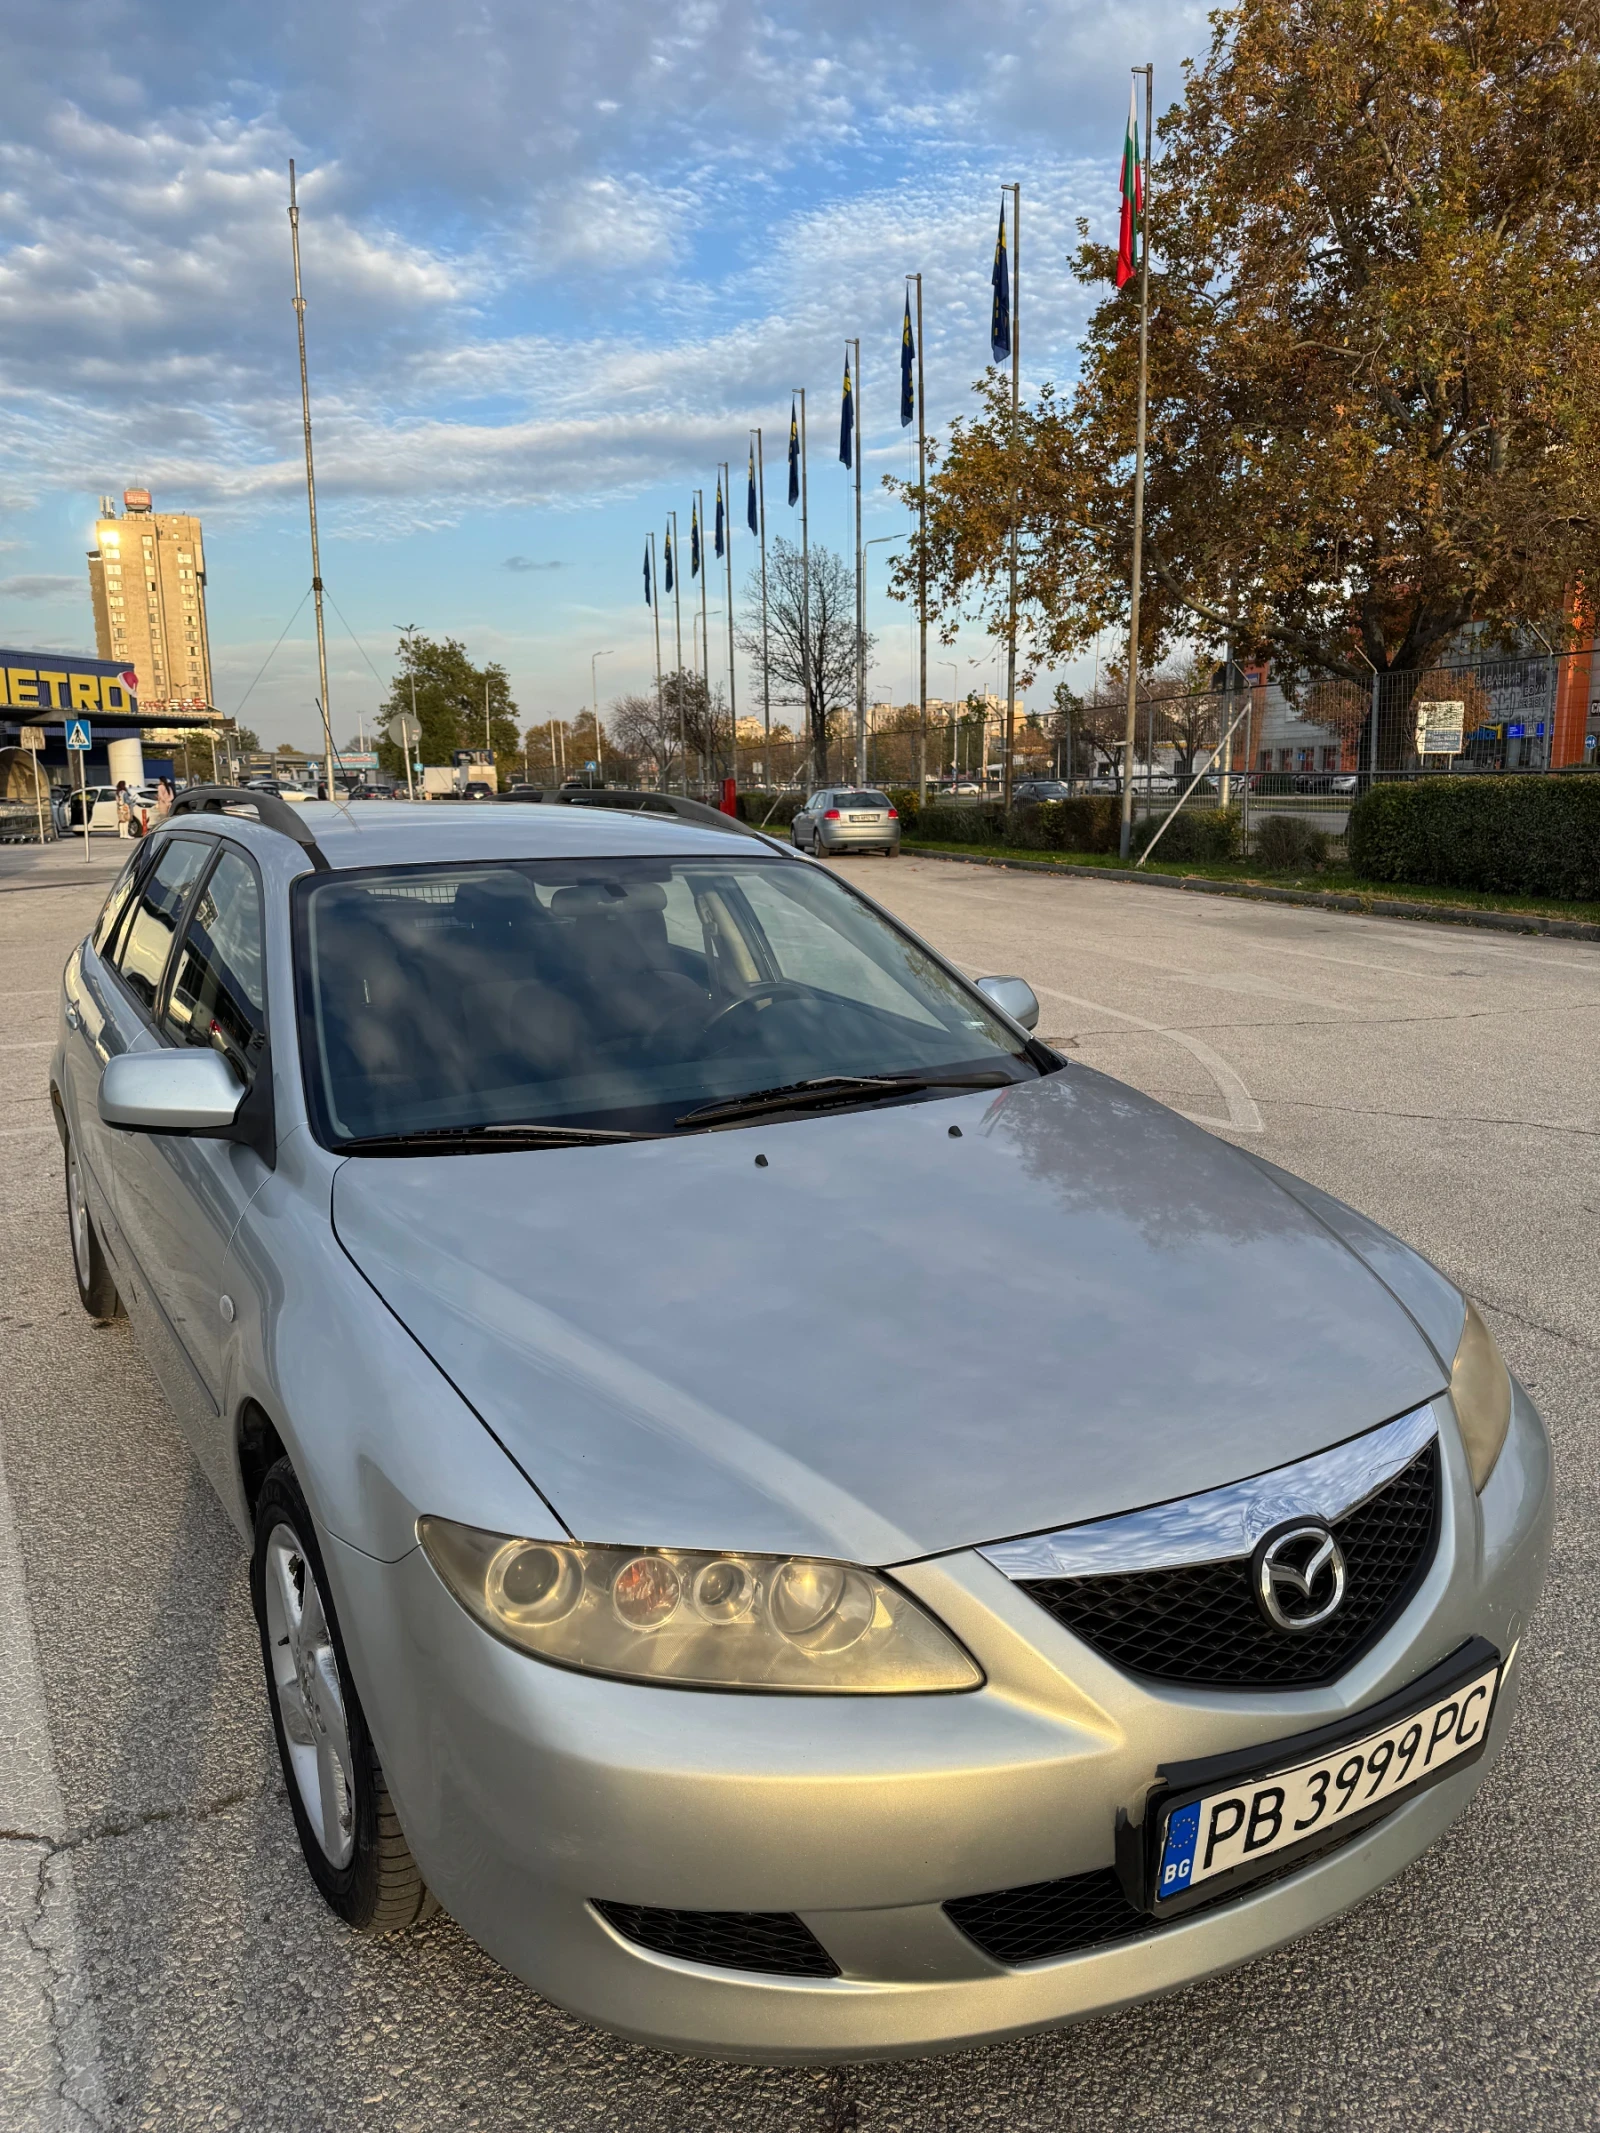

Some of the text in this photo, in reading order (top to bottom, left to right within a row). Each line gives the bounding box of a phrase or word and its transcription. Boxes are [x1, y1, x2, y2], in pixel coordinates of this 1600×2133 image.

[0, 667, 132, 713] ETRO
[1203, 1685, 1487, 1869] PB 3999 PC
[1164, 1858, 1190, 1884] BG
